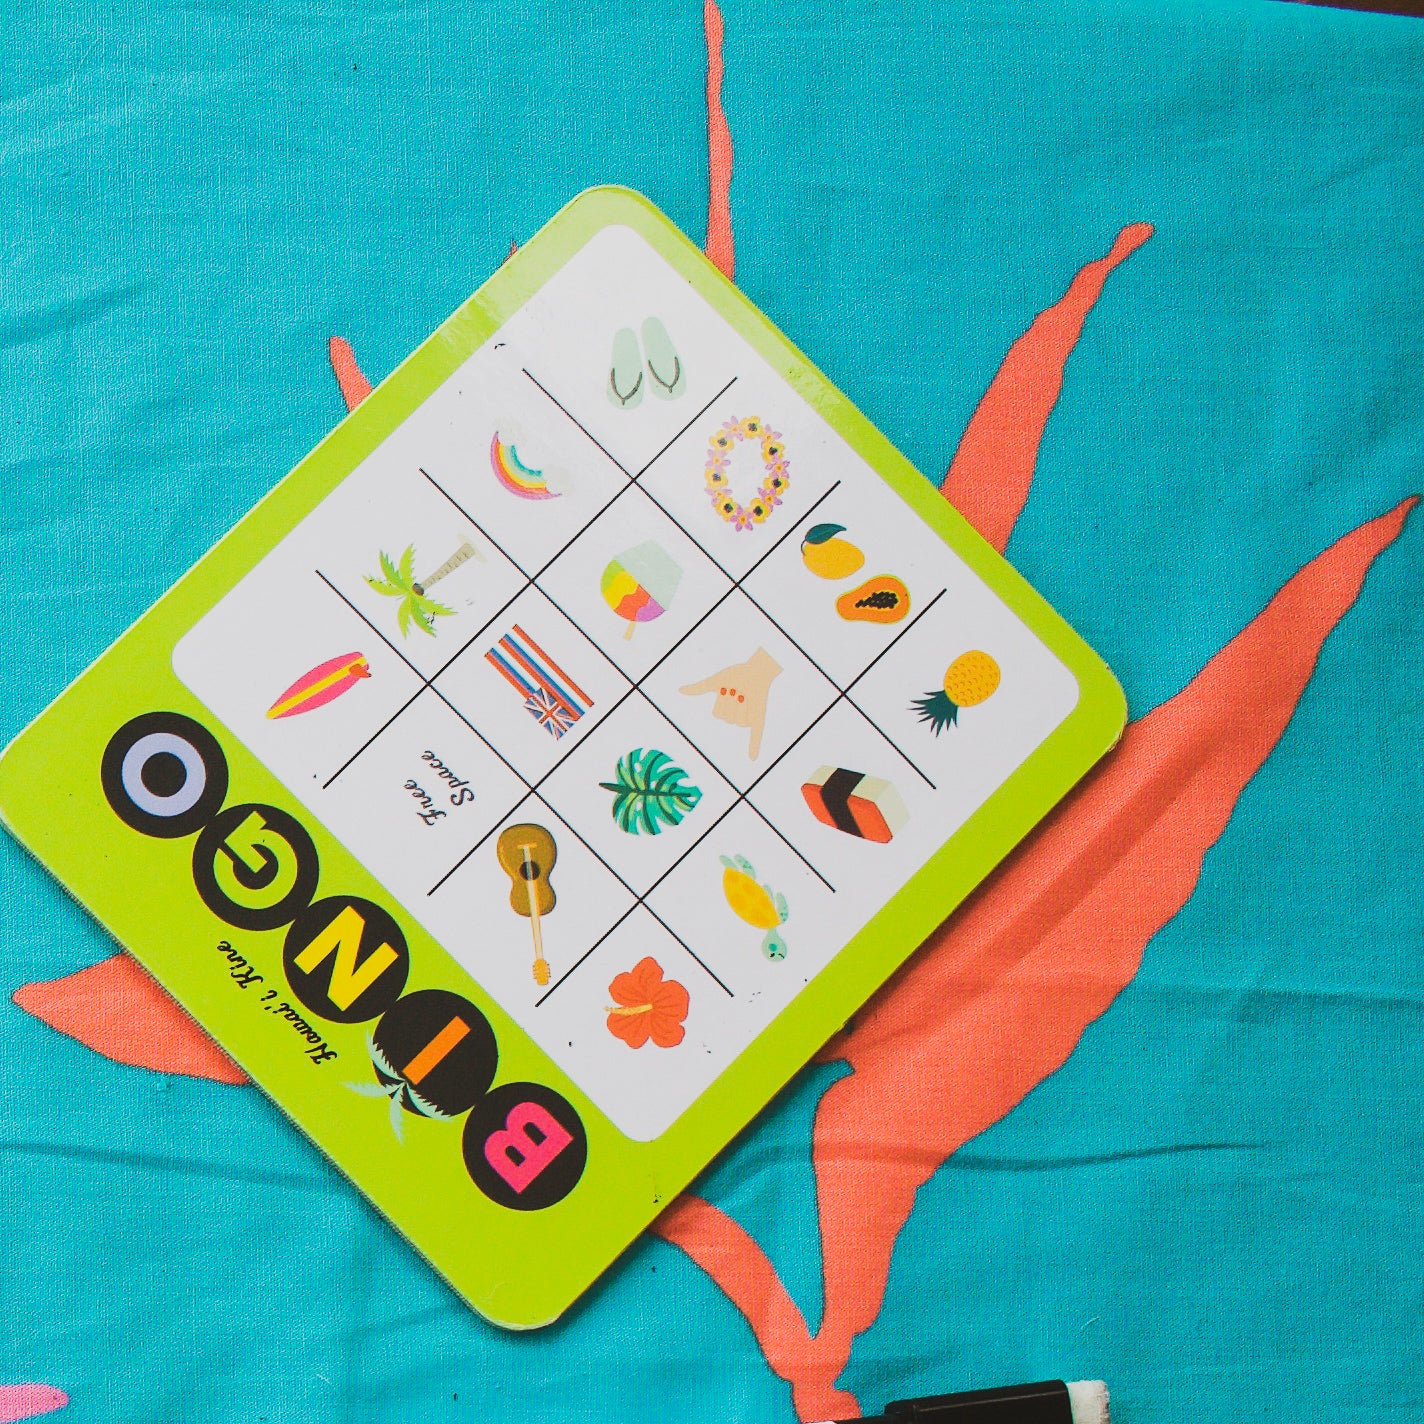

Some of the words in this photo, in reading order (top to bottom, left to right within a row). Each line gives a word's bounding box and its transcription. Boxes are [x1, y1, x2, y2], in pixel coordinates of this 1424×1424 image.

[403, 779, 447, 826] Free
[421, 750, 475, 807] Space
[121, 732, 574, 1194] BINGO
[216, 940, 264, 990] Kine
